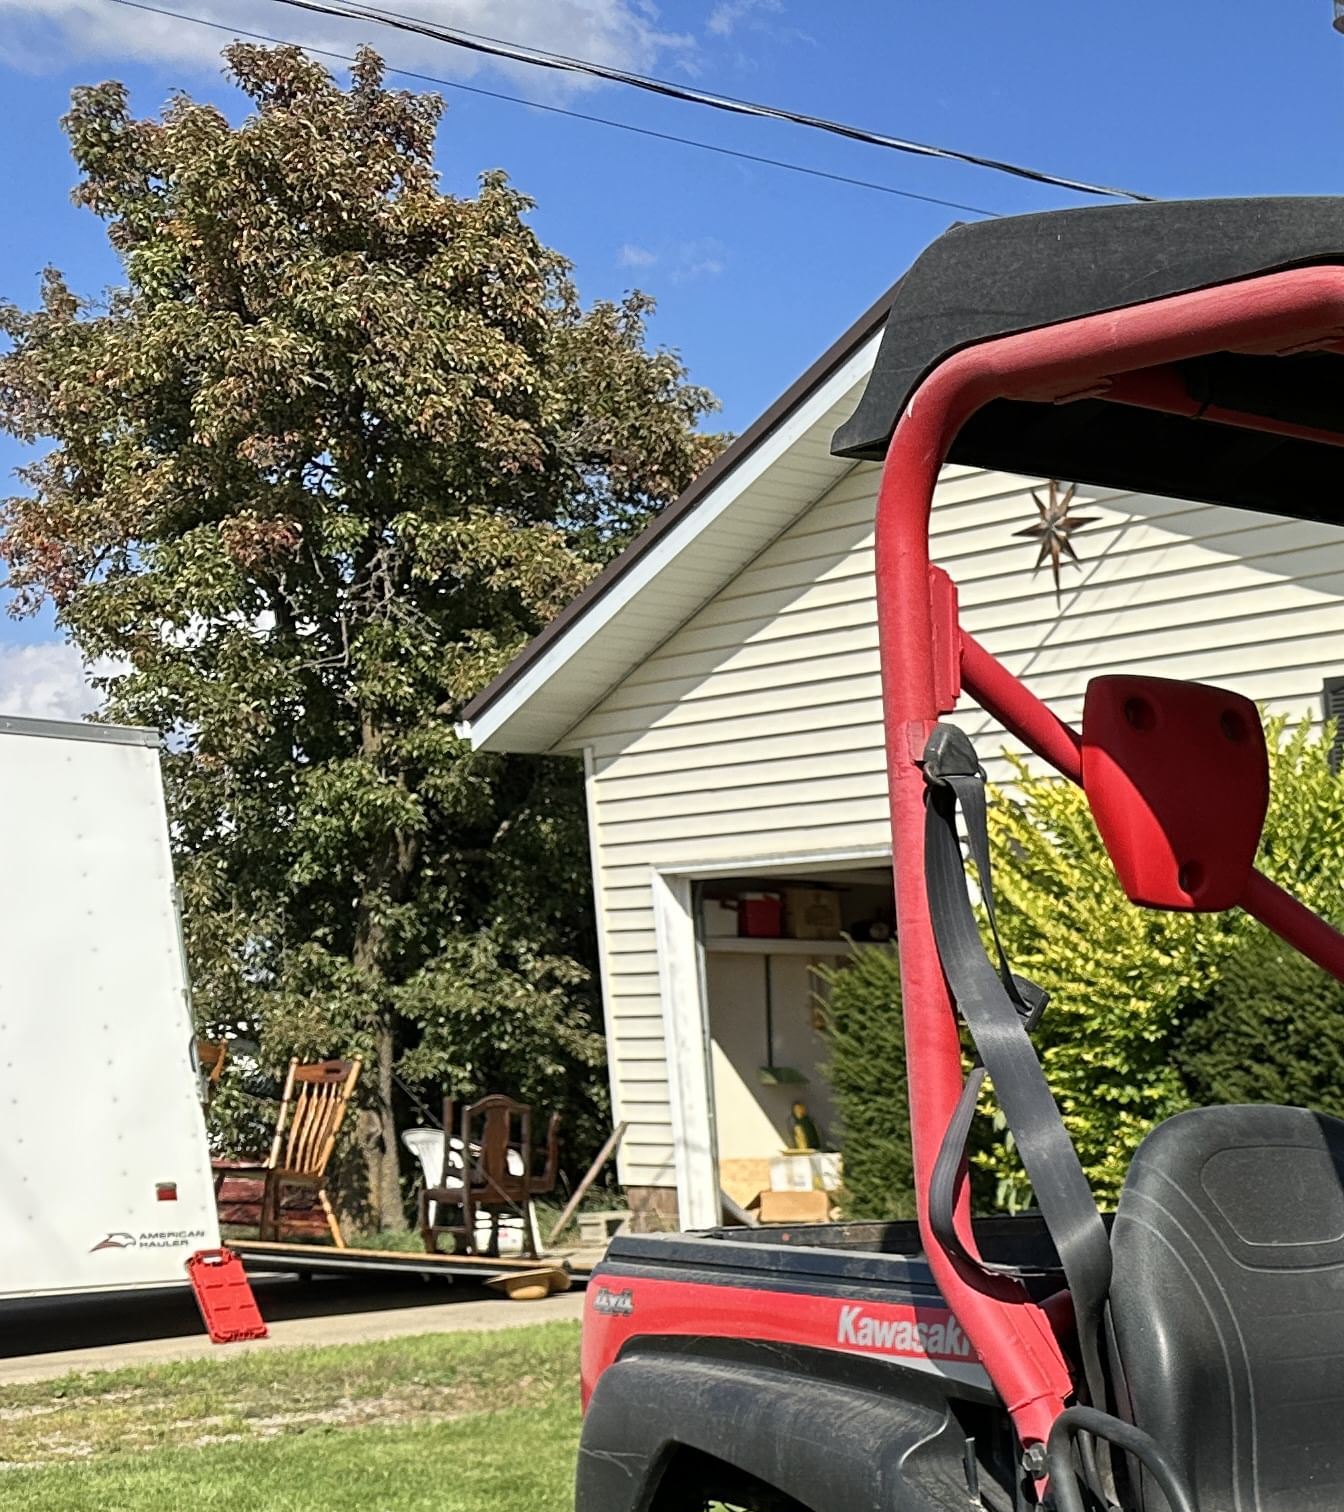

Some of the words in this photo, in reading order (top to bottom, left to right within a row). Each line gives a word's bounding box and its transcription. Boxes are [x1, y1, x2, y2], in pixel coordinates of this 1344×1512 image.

[139, 1230, 205, 1240] AMERICAN
[139, 1240, 189, 1248] HAULER
[837, 1305, 970, 1357] Kawasaki
